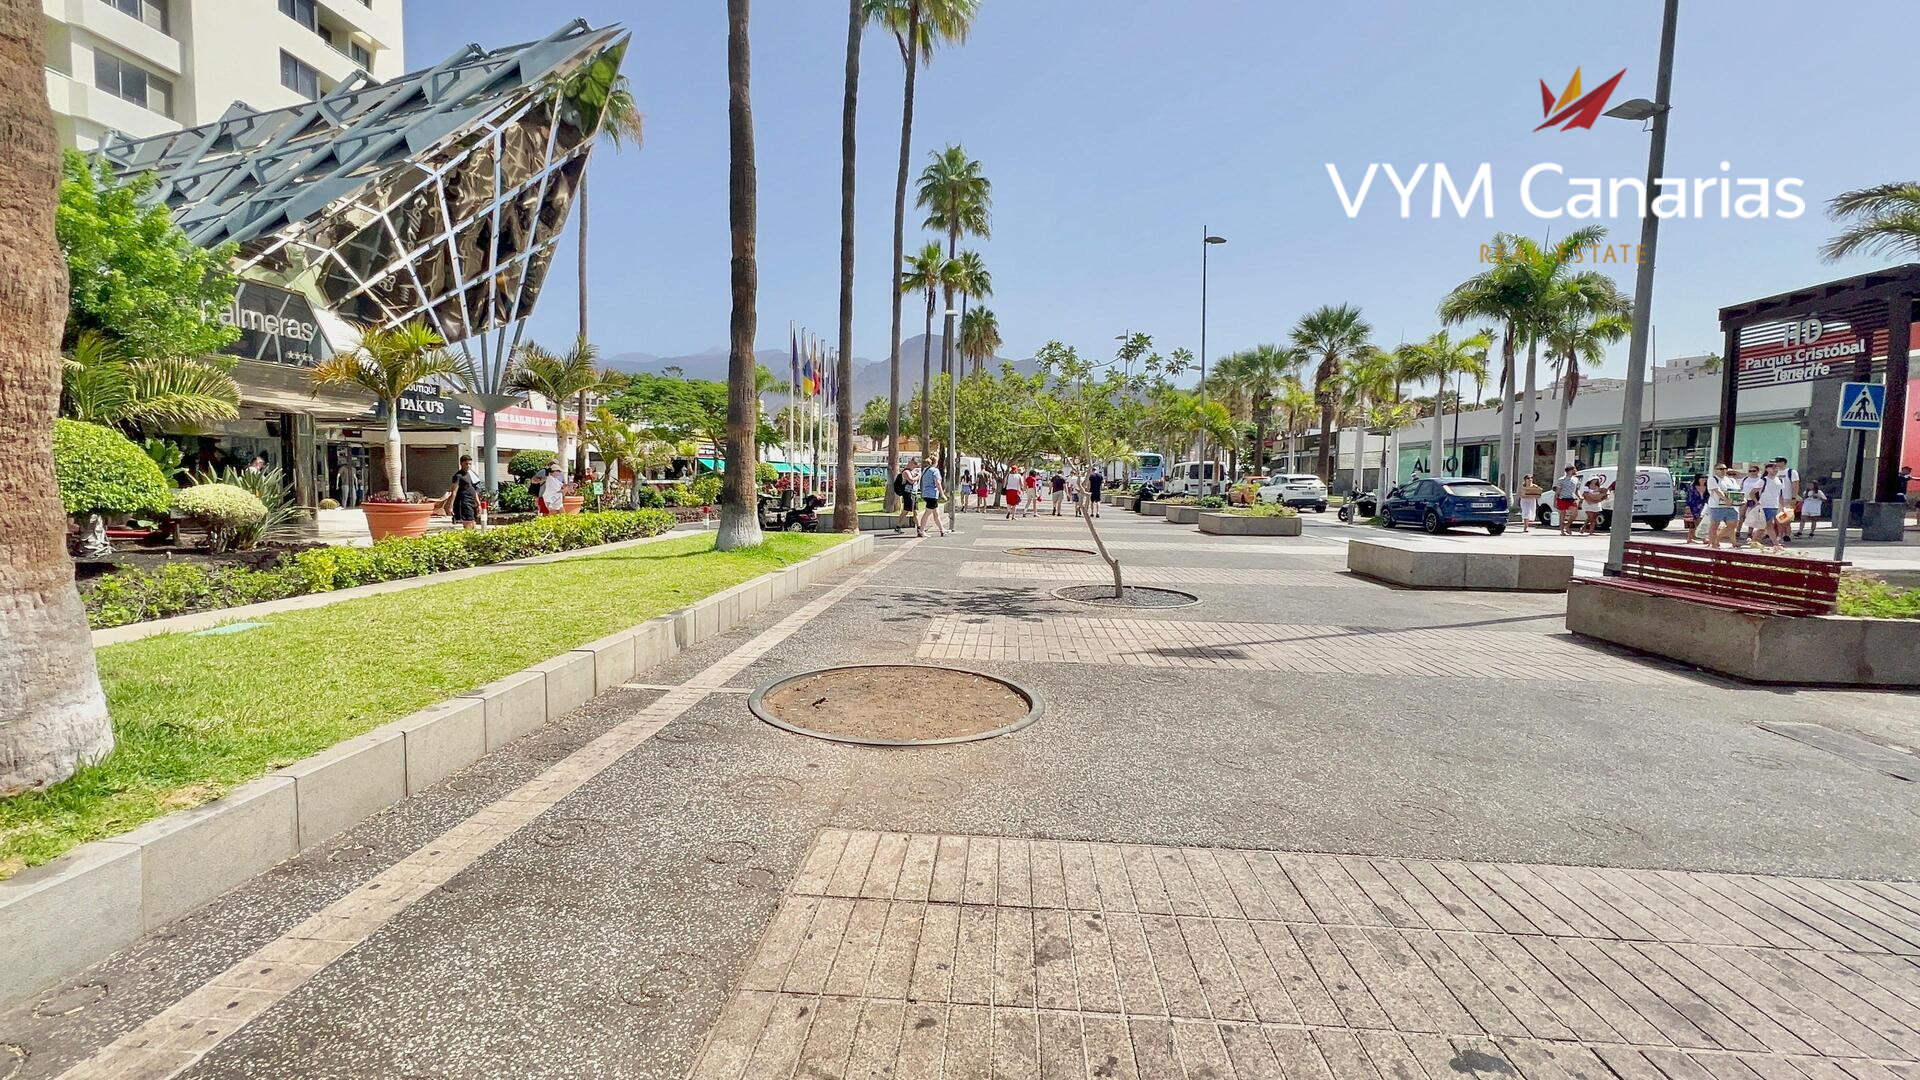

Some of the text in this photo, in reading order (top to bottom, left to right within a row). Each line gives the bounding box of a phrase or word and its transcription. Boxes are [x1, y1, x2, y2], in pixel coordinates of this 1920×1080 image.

[1745, 339, 1866, 370] Parque Cristóbal
[1773, 363, 1830, 382] Tenerife
[404, 384, 437, 395] OUTIQUE
[1413, 456, 1459, 474] ALO
